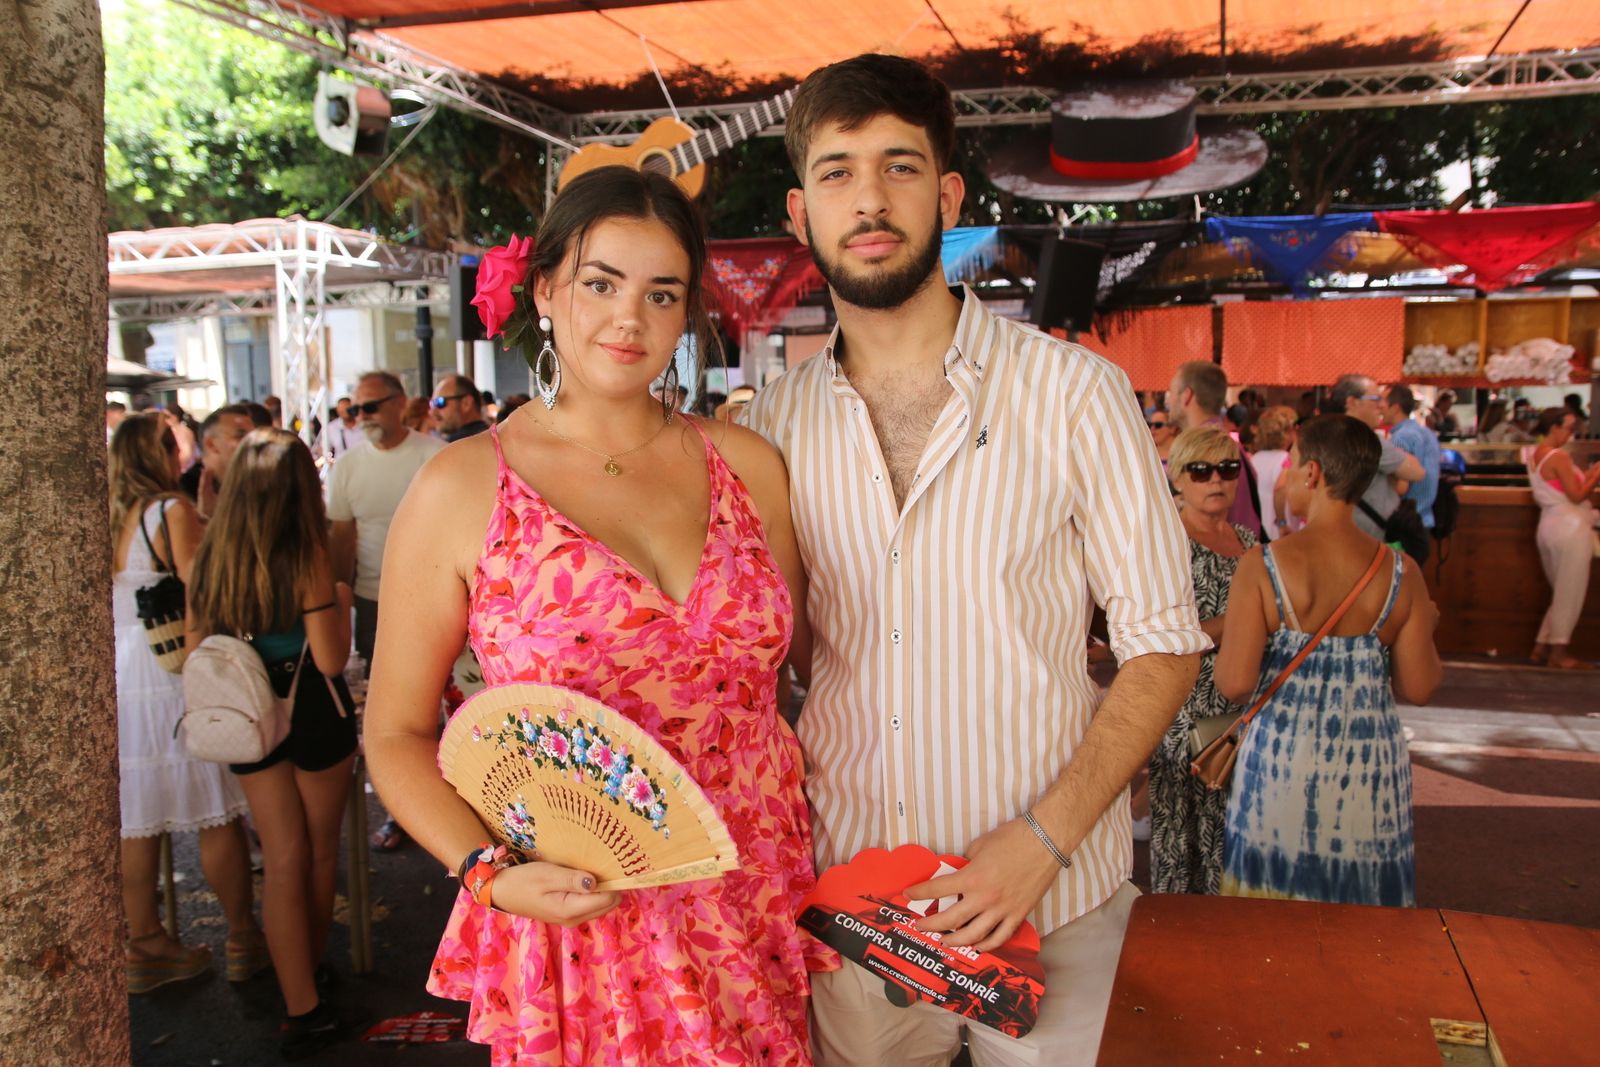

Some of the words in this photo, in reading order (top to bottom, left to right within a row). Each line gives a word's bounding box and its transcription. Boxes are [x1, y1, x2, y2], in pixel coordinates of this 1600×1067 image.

[835, 913, 894, 952] COMPRA,
[897, 943, 945, 978] VENDE,
[946, 969, 1001, 1004] SONRÍE
[893, 926, 927, 949] Felicidad
[926, 942, 936, 953] de
[935, 948, 956, 962] Serie
[867, 959, 948, 1002] www.crestanevada.es
